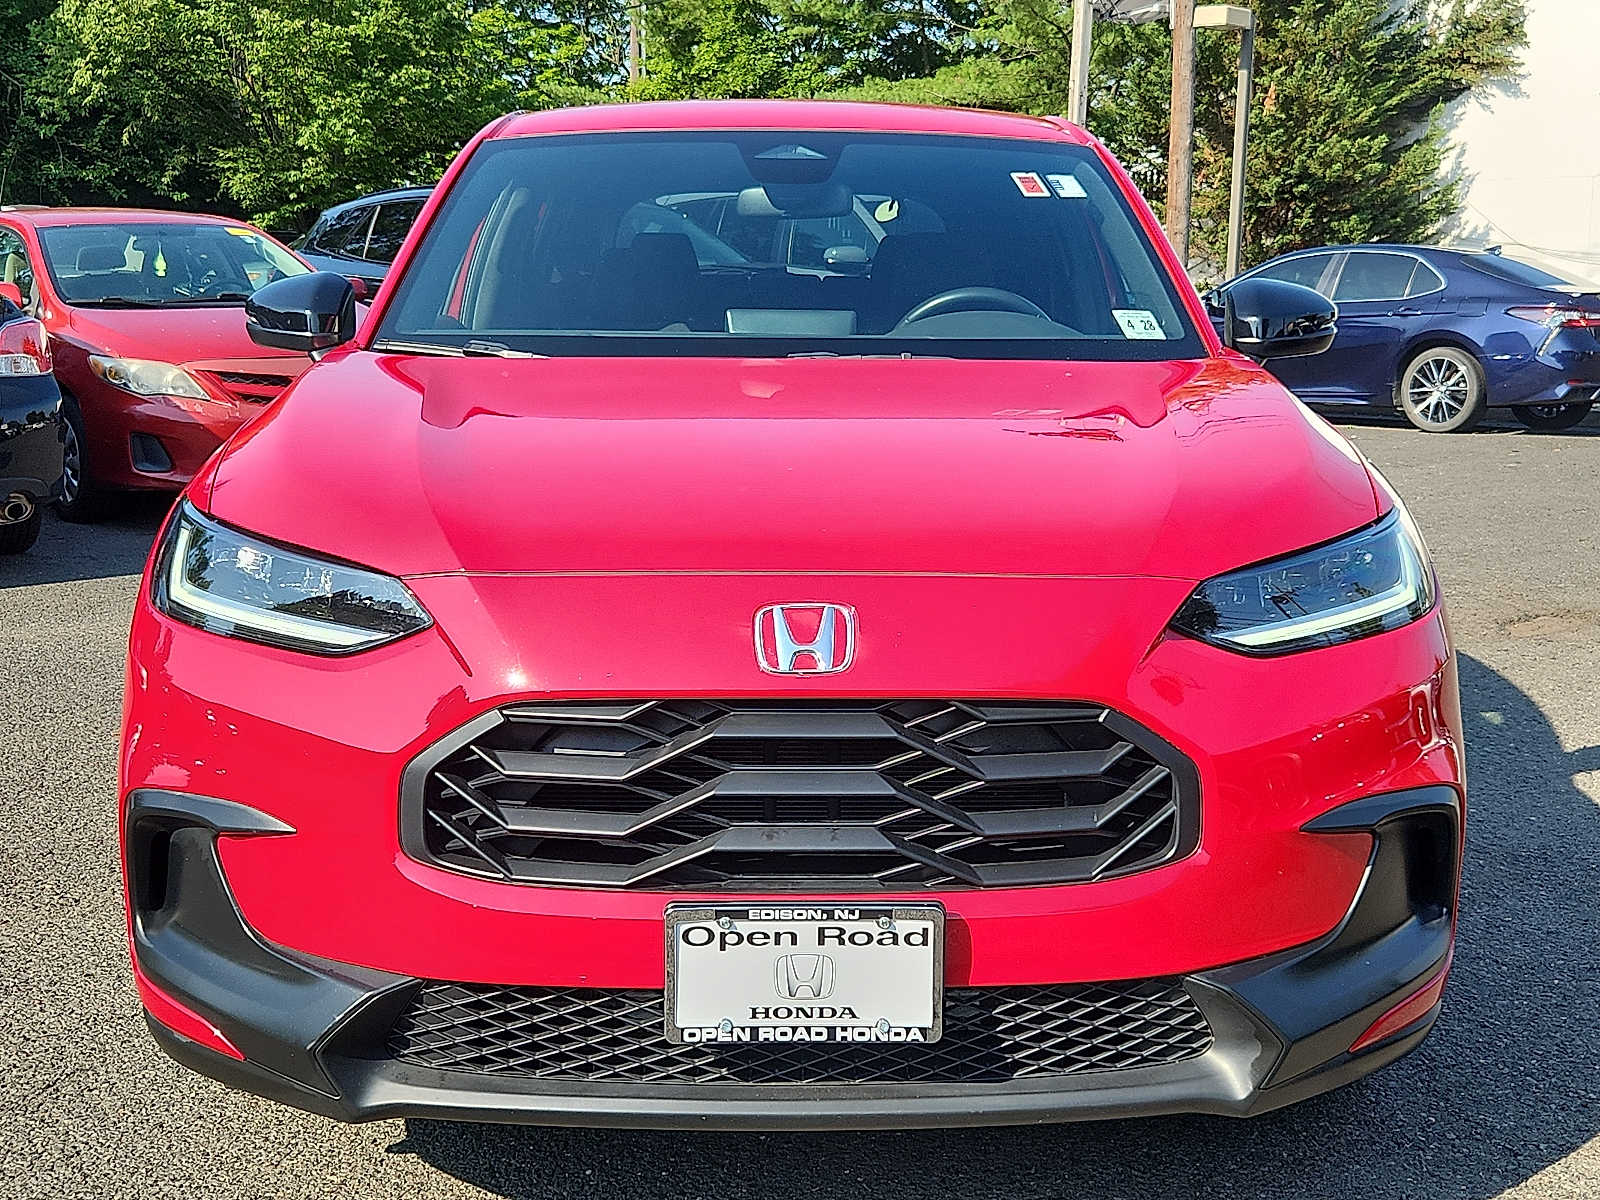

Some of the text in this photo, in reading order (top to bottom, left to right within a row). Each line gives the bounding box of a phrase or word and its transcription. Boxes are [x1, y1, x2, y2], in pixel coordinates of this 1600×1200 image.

[1140, 319, 1156, 331] 28
[749, 909, 860, 920] EDISON, NJ
[681, 926, 929, 951] Open Road
[749, 1007, 860, 1020] HONDA
[683, 1027, 925, 1042] OPEN ROAD HONDA
